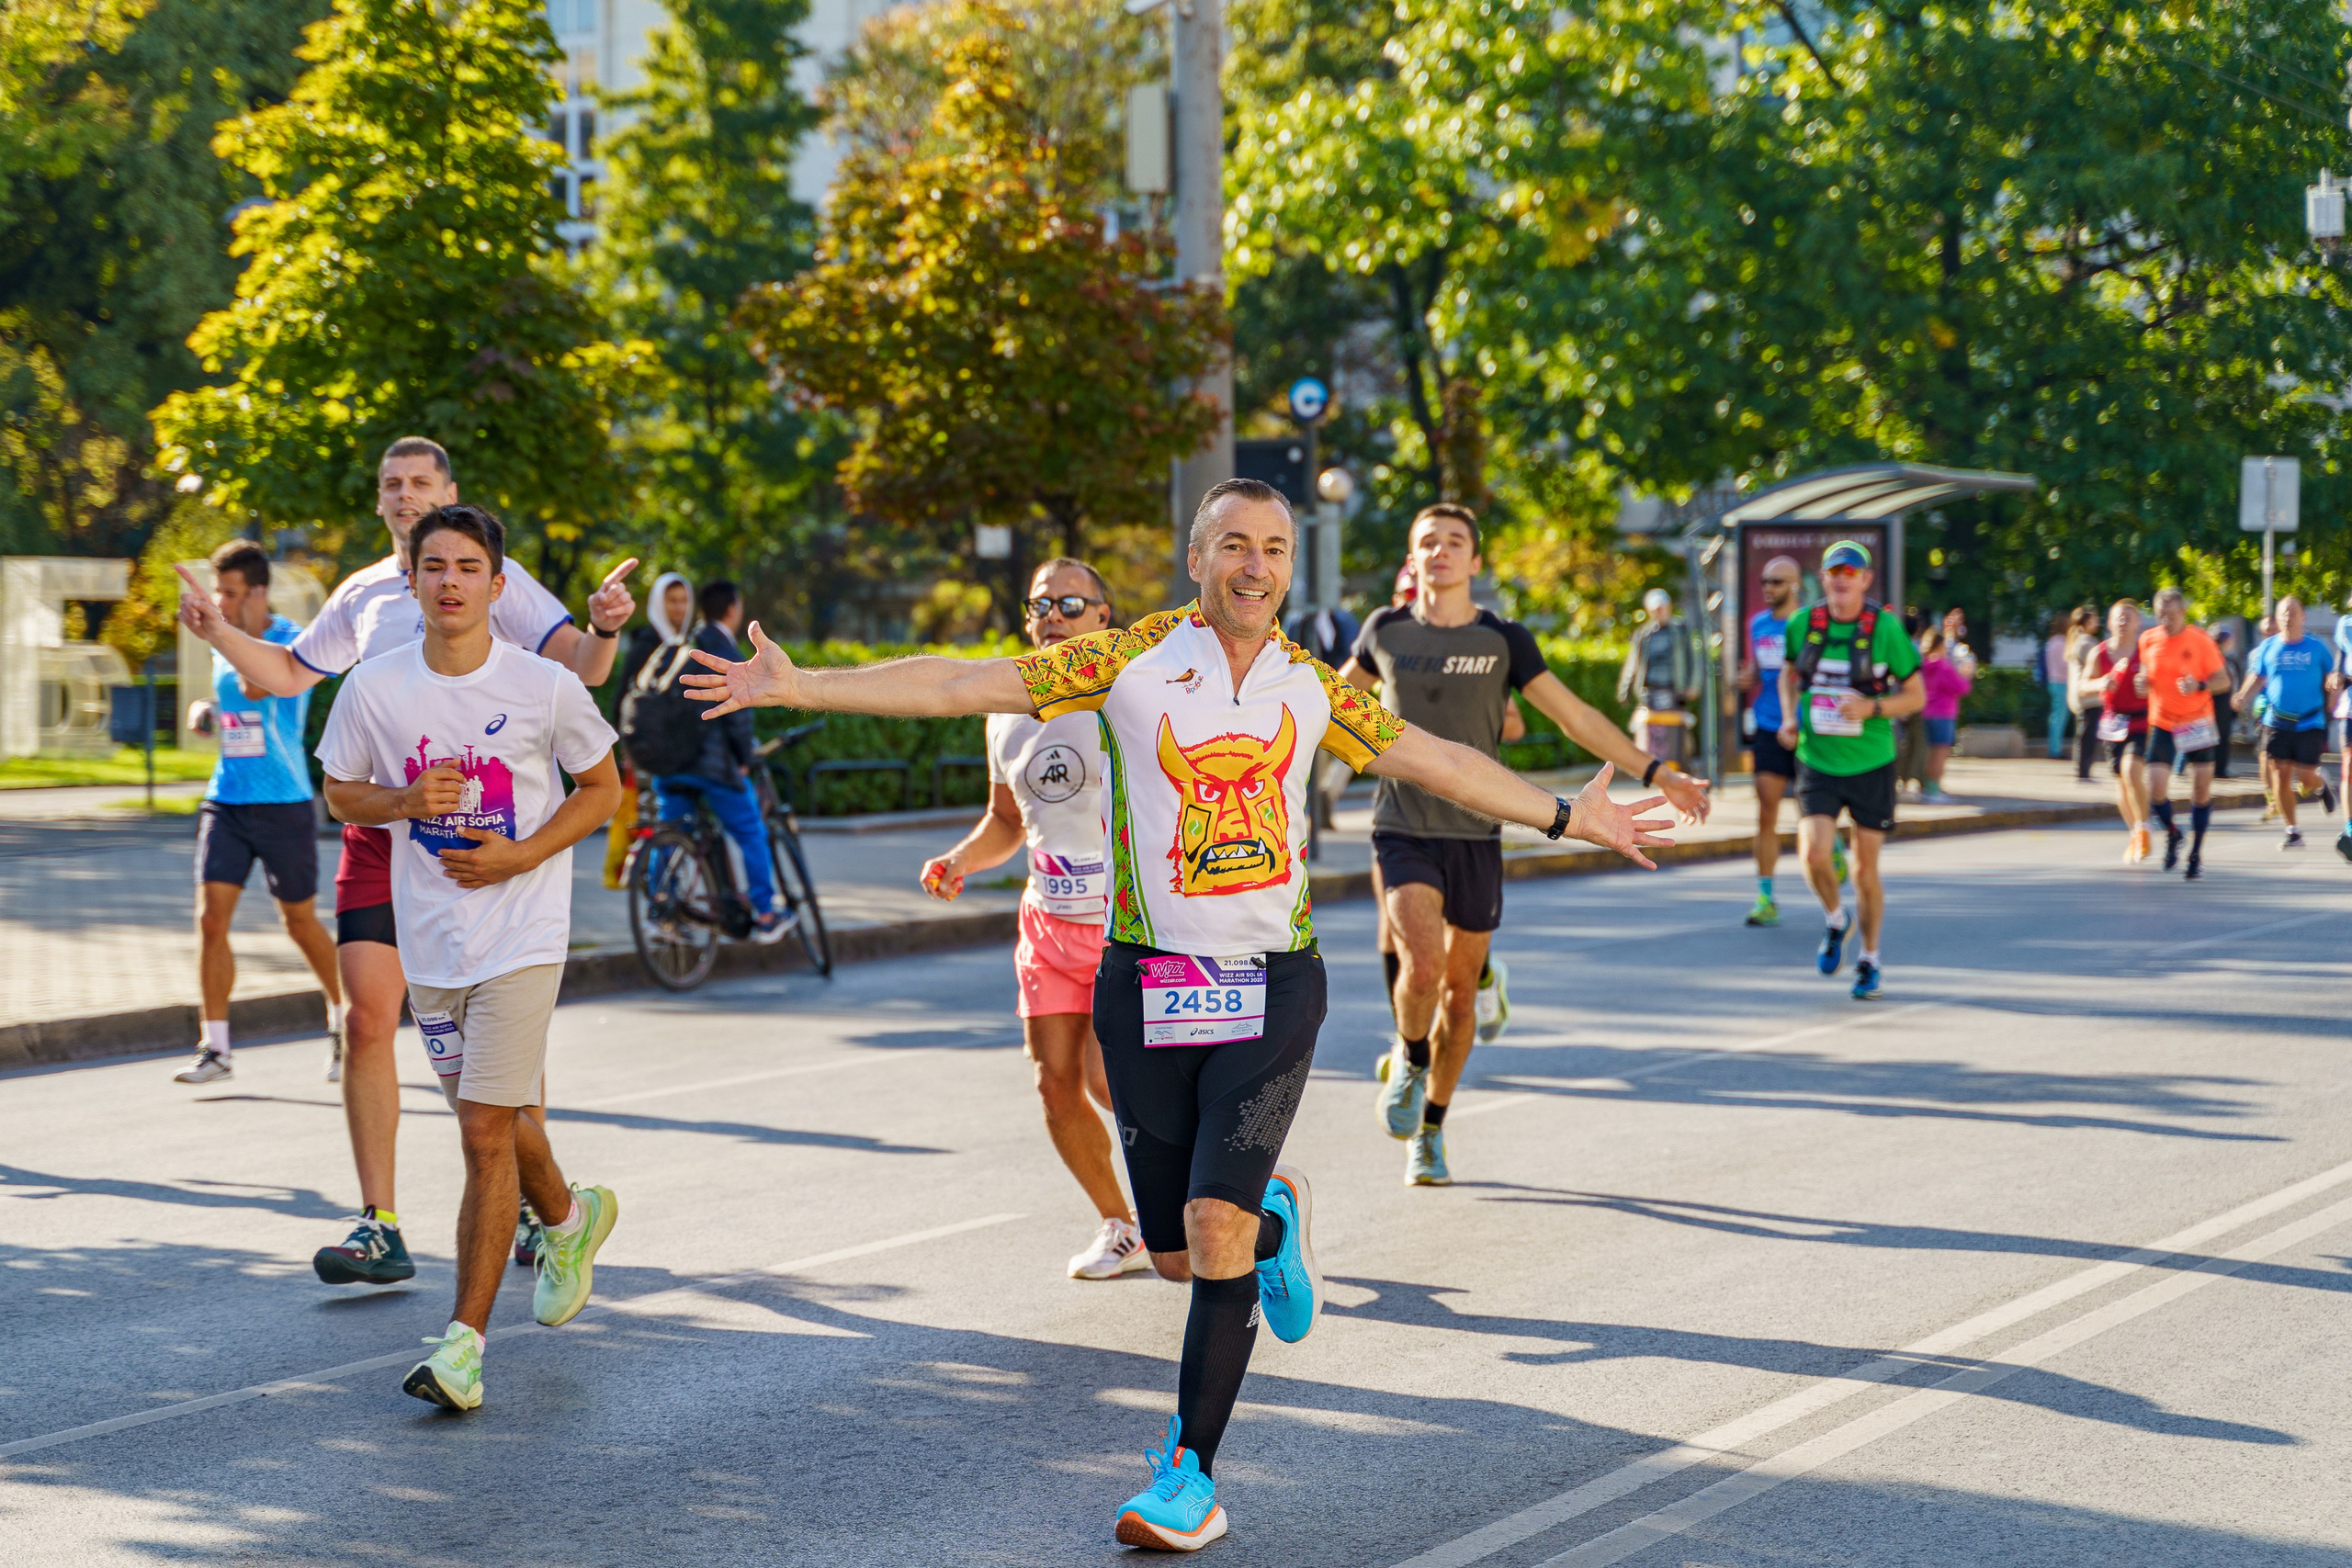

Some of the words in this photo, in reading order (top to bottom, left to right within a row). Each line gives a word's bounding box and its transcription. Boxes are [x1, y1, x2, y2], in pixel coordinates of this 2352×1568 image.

[1443, 656, 1498, 673] START
[445, 816, 466, 827] AIR
[469, 813, 505, 827] SOFIA
[1043, 876, 1088, 895] 1995
[1164, 989, 1242, 1014] 2458
